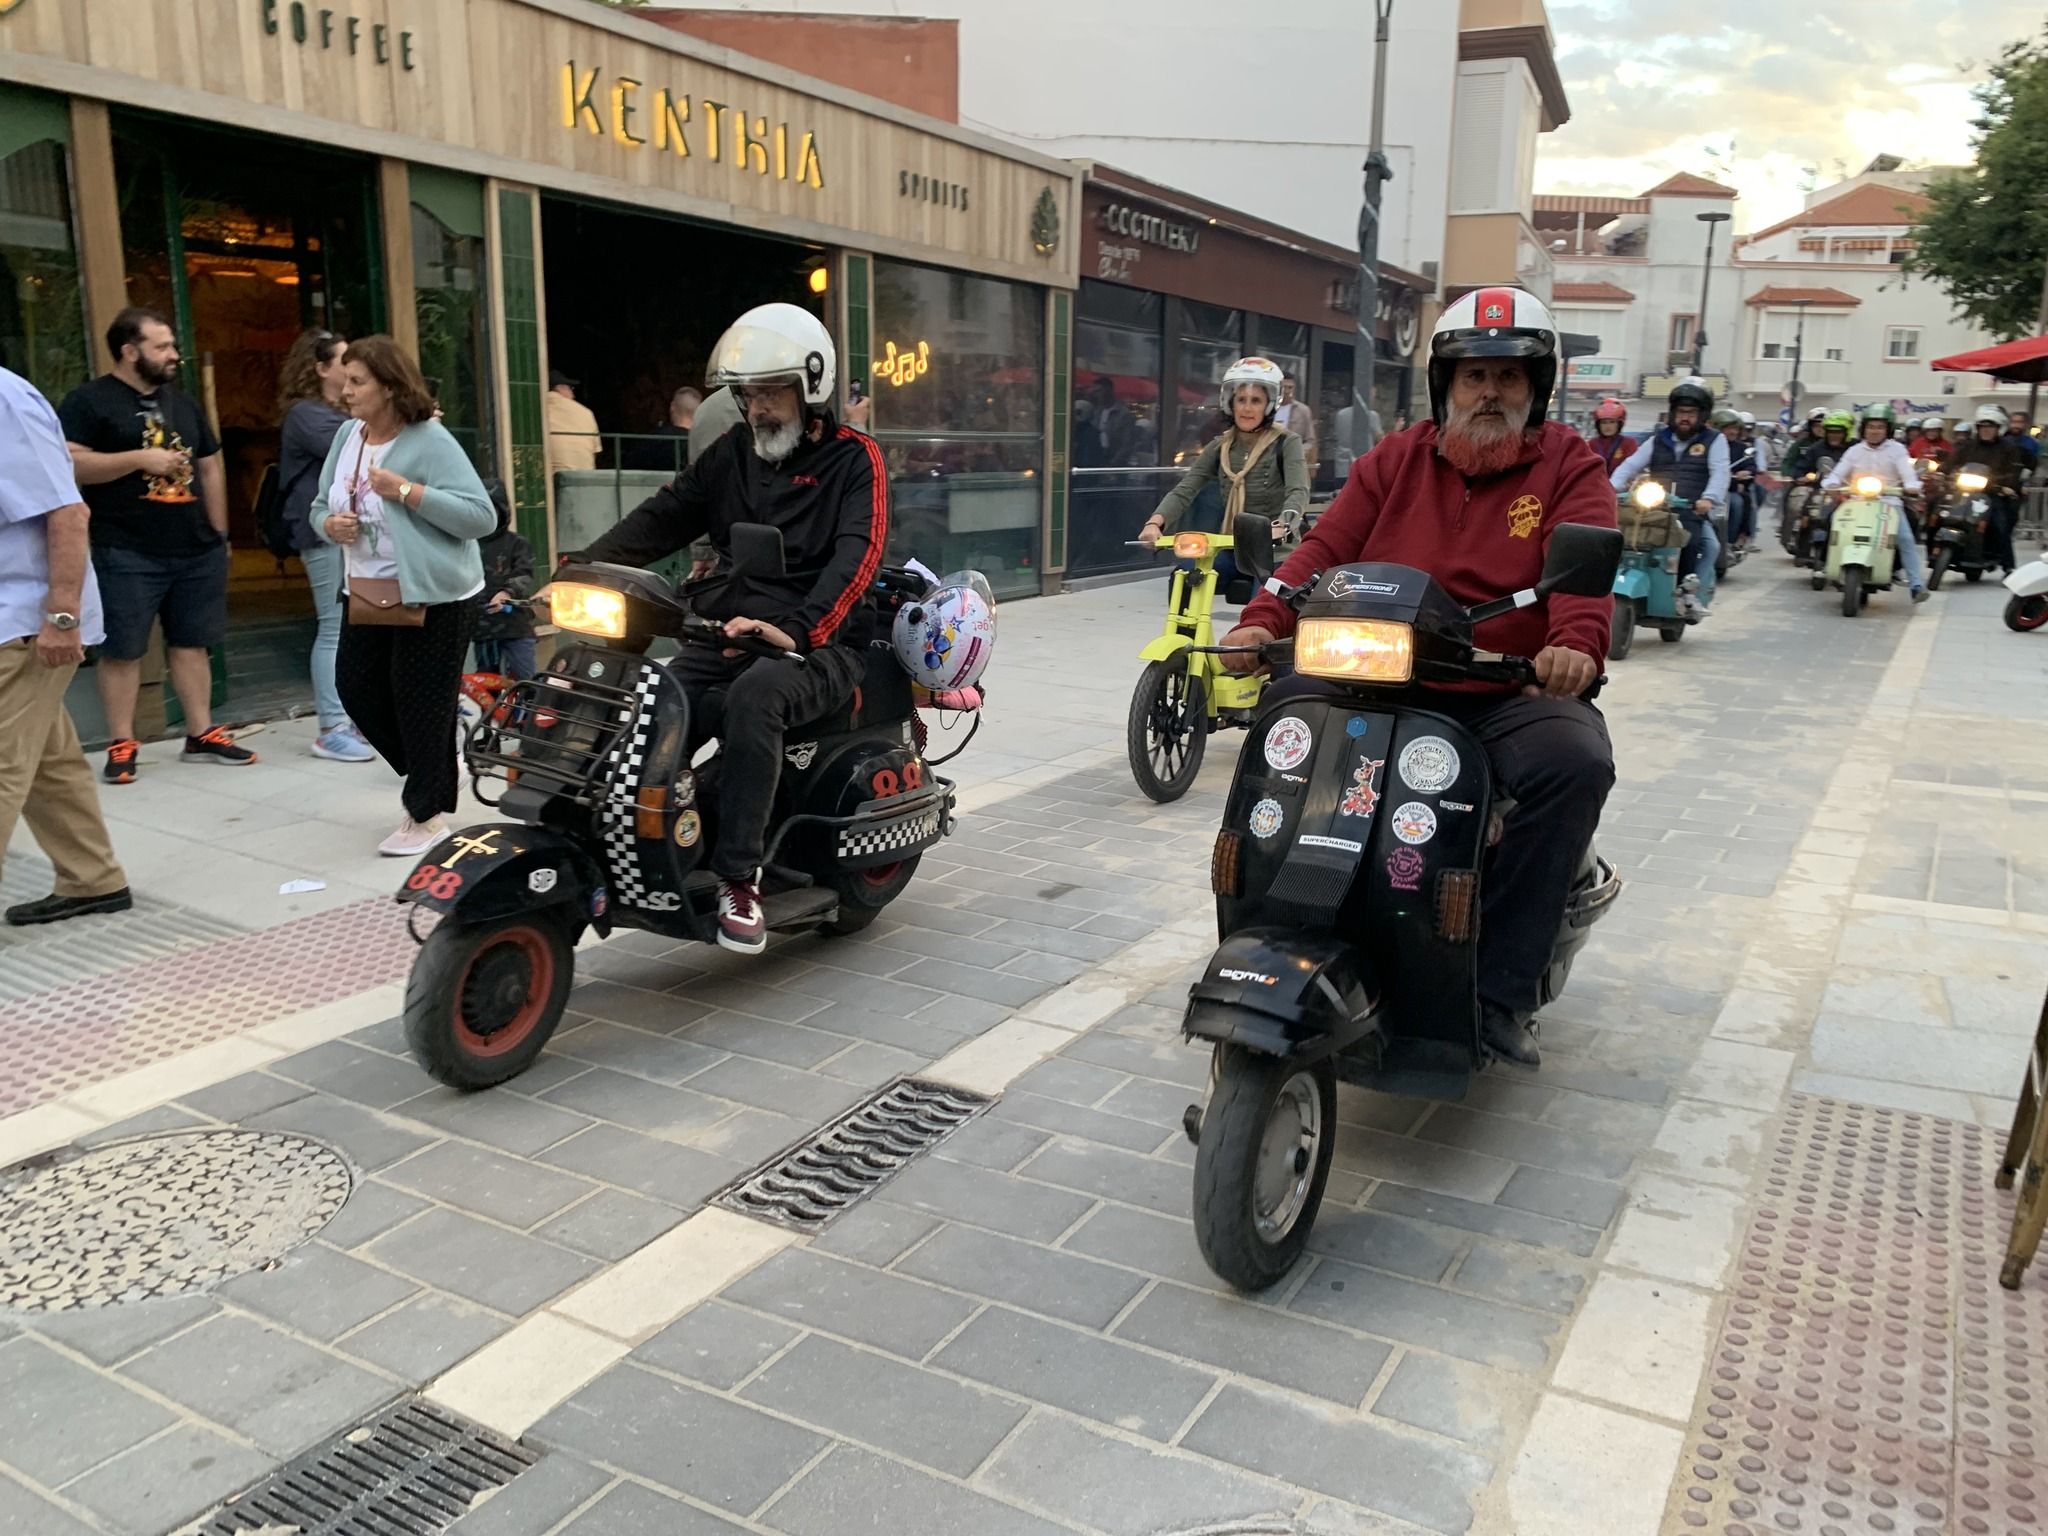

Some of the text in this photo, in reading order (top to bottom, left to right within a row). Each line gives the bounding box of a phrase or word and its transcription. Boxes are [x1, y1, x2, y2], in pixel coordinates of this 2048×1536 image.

[261, 0, 415, 71] COFFEE
[899, 170, 970, 212] SPIRITS
[1303, 836, 1359, 850] SUPERCHARGED
[407, 864, 464, 900] 88
